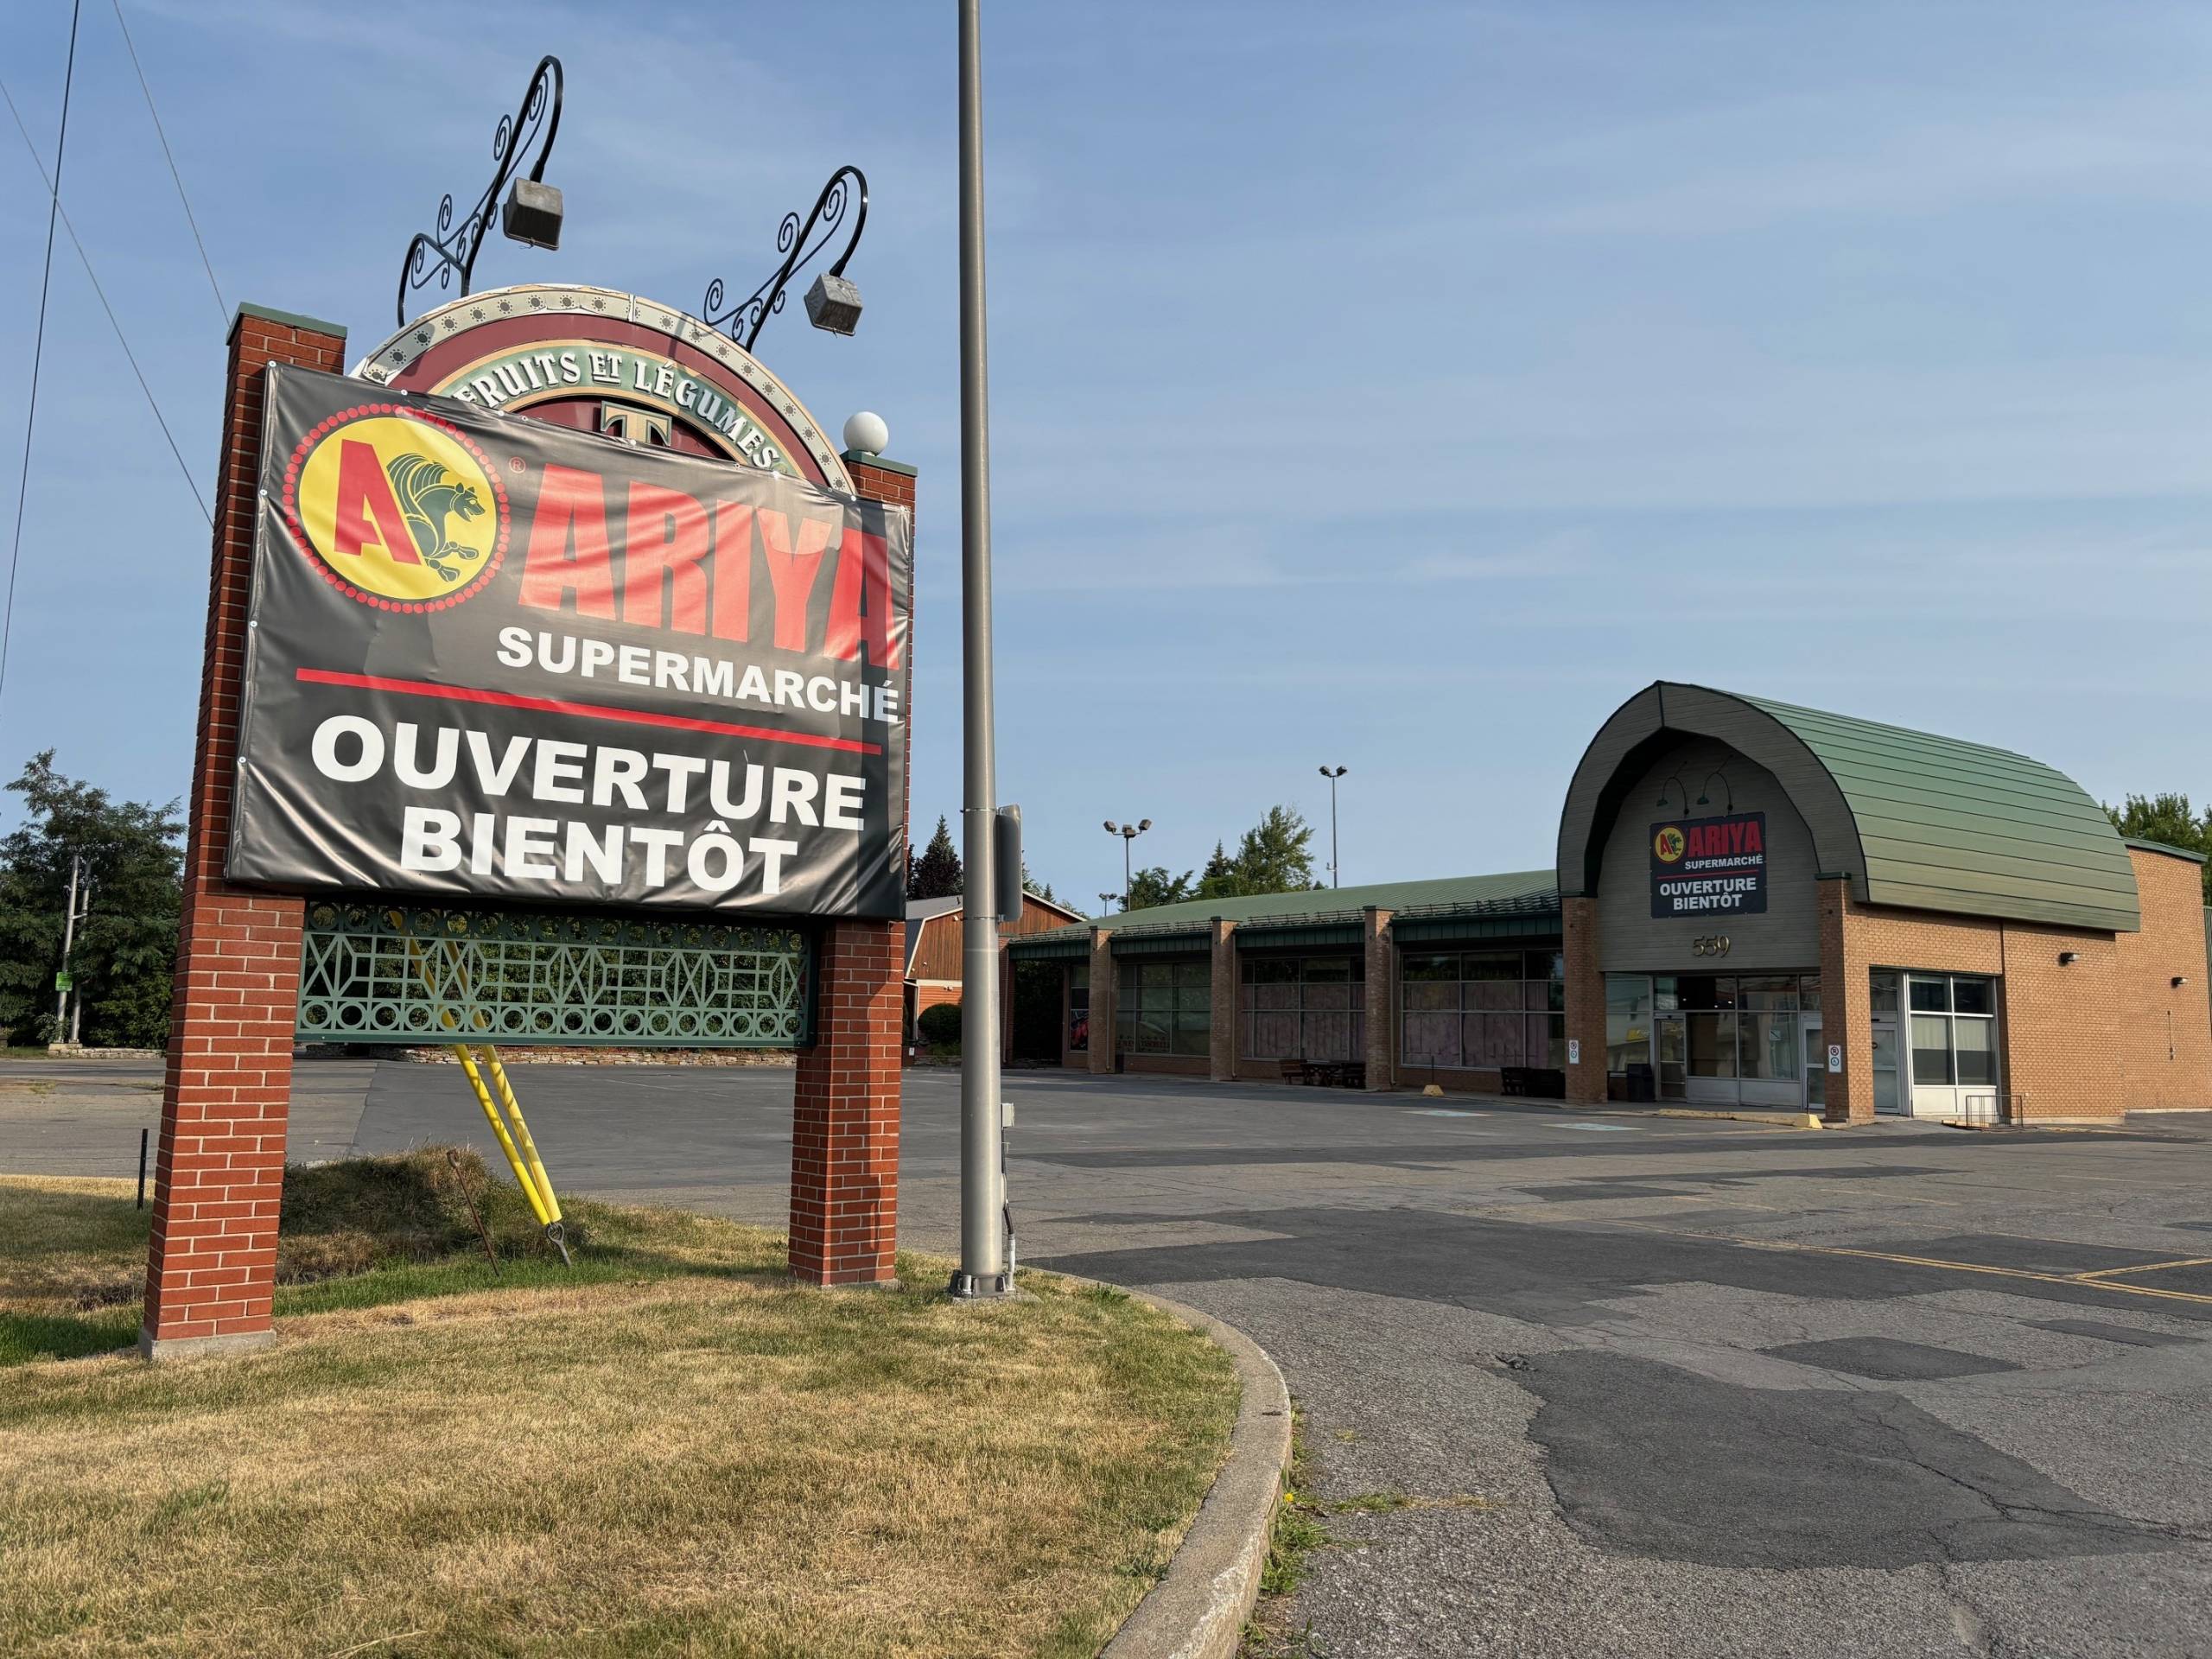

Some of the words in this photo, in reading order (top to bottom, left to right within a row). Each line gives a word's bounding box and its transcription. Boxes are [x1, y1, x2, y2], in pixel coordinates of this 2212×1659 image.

[453, 352, 581, 408] FRUITS
[589, 352, 622, 384] ET
[635, 359, 780, 468] LÉGUMES
[518, 463, 899, 671] ARIYA
[496, 626, 899, 723] SUPERMARCHÉ
[311, 715, 866, 832] OUVERTURE
[400, 804, 798, 894] BIENTÔT
[1685, 854, 1764, 870] SUPERMARCHÉ
[1688, 821, 1763, 858] ARIYA
[1659, 877, 1757, 896] OUVERTURE
[1673, 893, 1743, 911] BIENTÔT
[1693, 935, 1731, 958] 559
